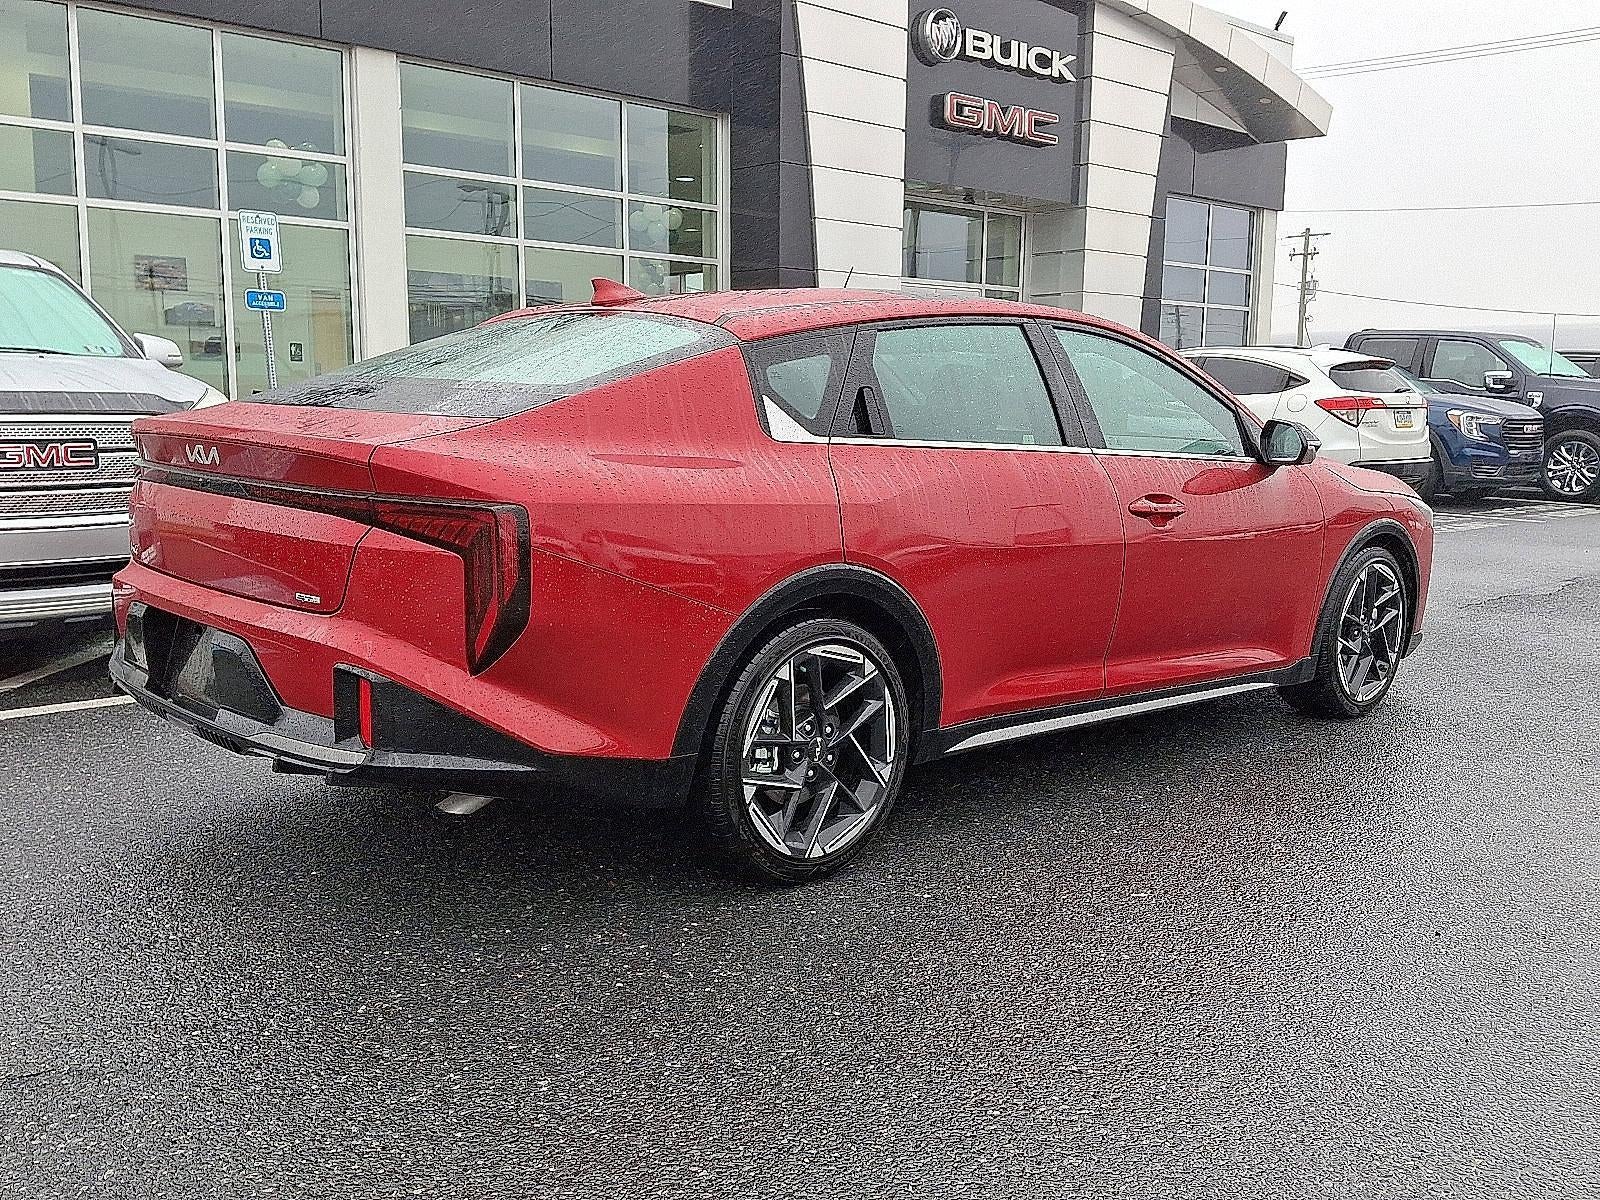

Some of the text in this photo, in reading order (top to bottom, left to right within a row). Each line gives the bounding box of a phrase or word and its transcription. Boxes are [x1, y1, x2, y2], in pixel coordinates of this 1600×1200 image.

[965, 28, 1077, 82] BUICK
[946, 91, 1060, 145] GMC
[241, 215, 275, 226] RESERVED
[245, 226, 273, 236] PARKING
[257, 293, 274, 302] VAN
[0, 442, 96, 468] GMC
[185, 443, 220, 467] KIA
